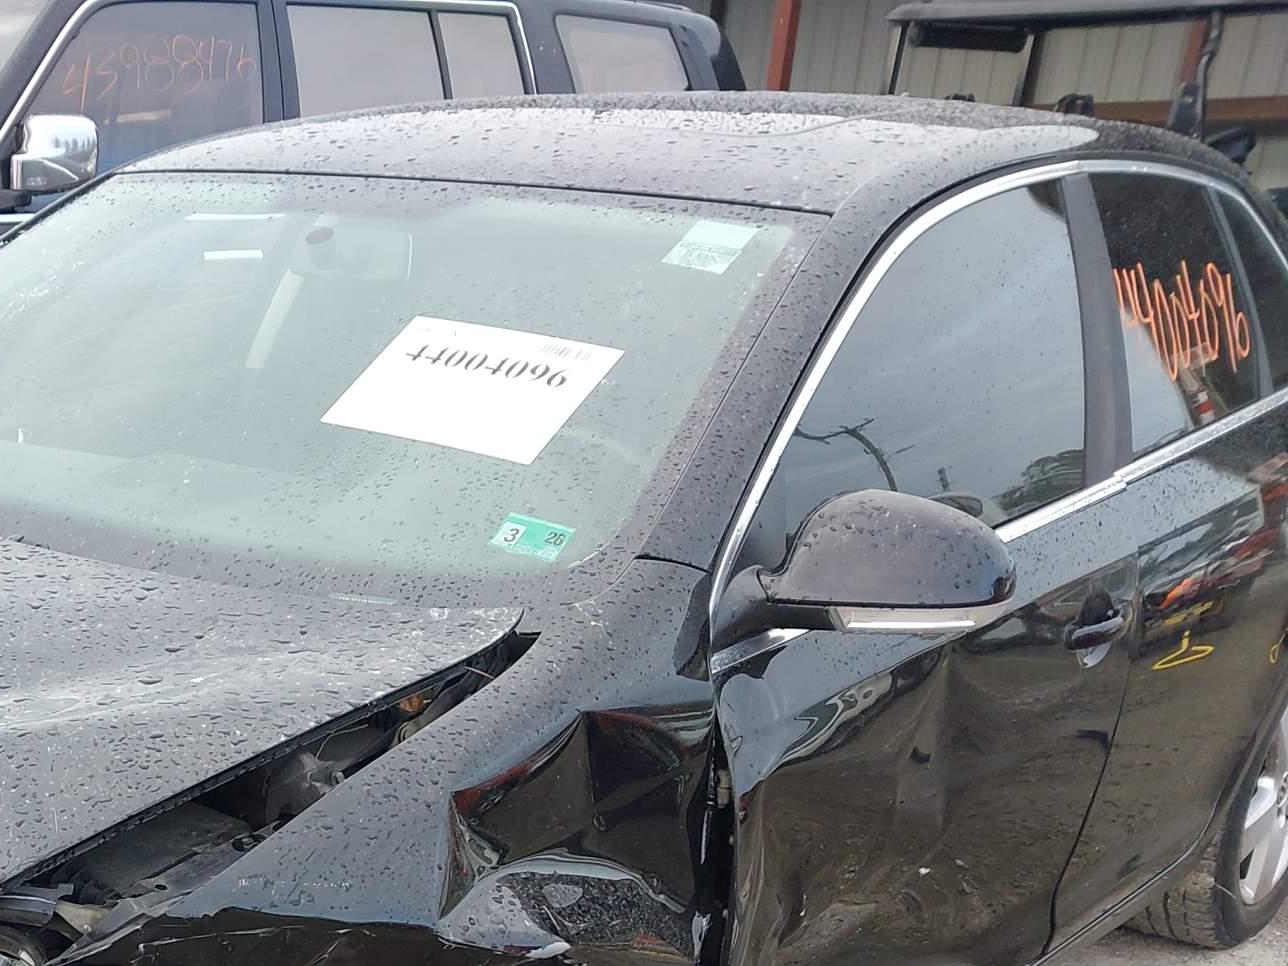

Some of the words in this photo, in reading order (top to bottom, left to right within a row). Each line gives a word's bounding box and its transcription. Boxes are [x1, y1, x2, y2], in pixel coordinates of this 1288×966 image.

[1113, 259, 1250, 381] 44004096
[406, 344, 569, 388] 44004096
[503, 528, 520, 543] 3
[544, 531, 567, 546] 26
